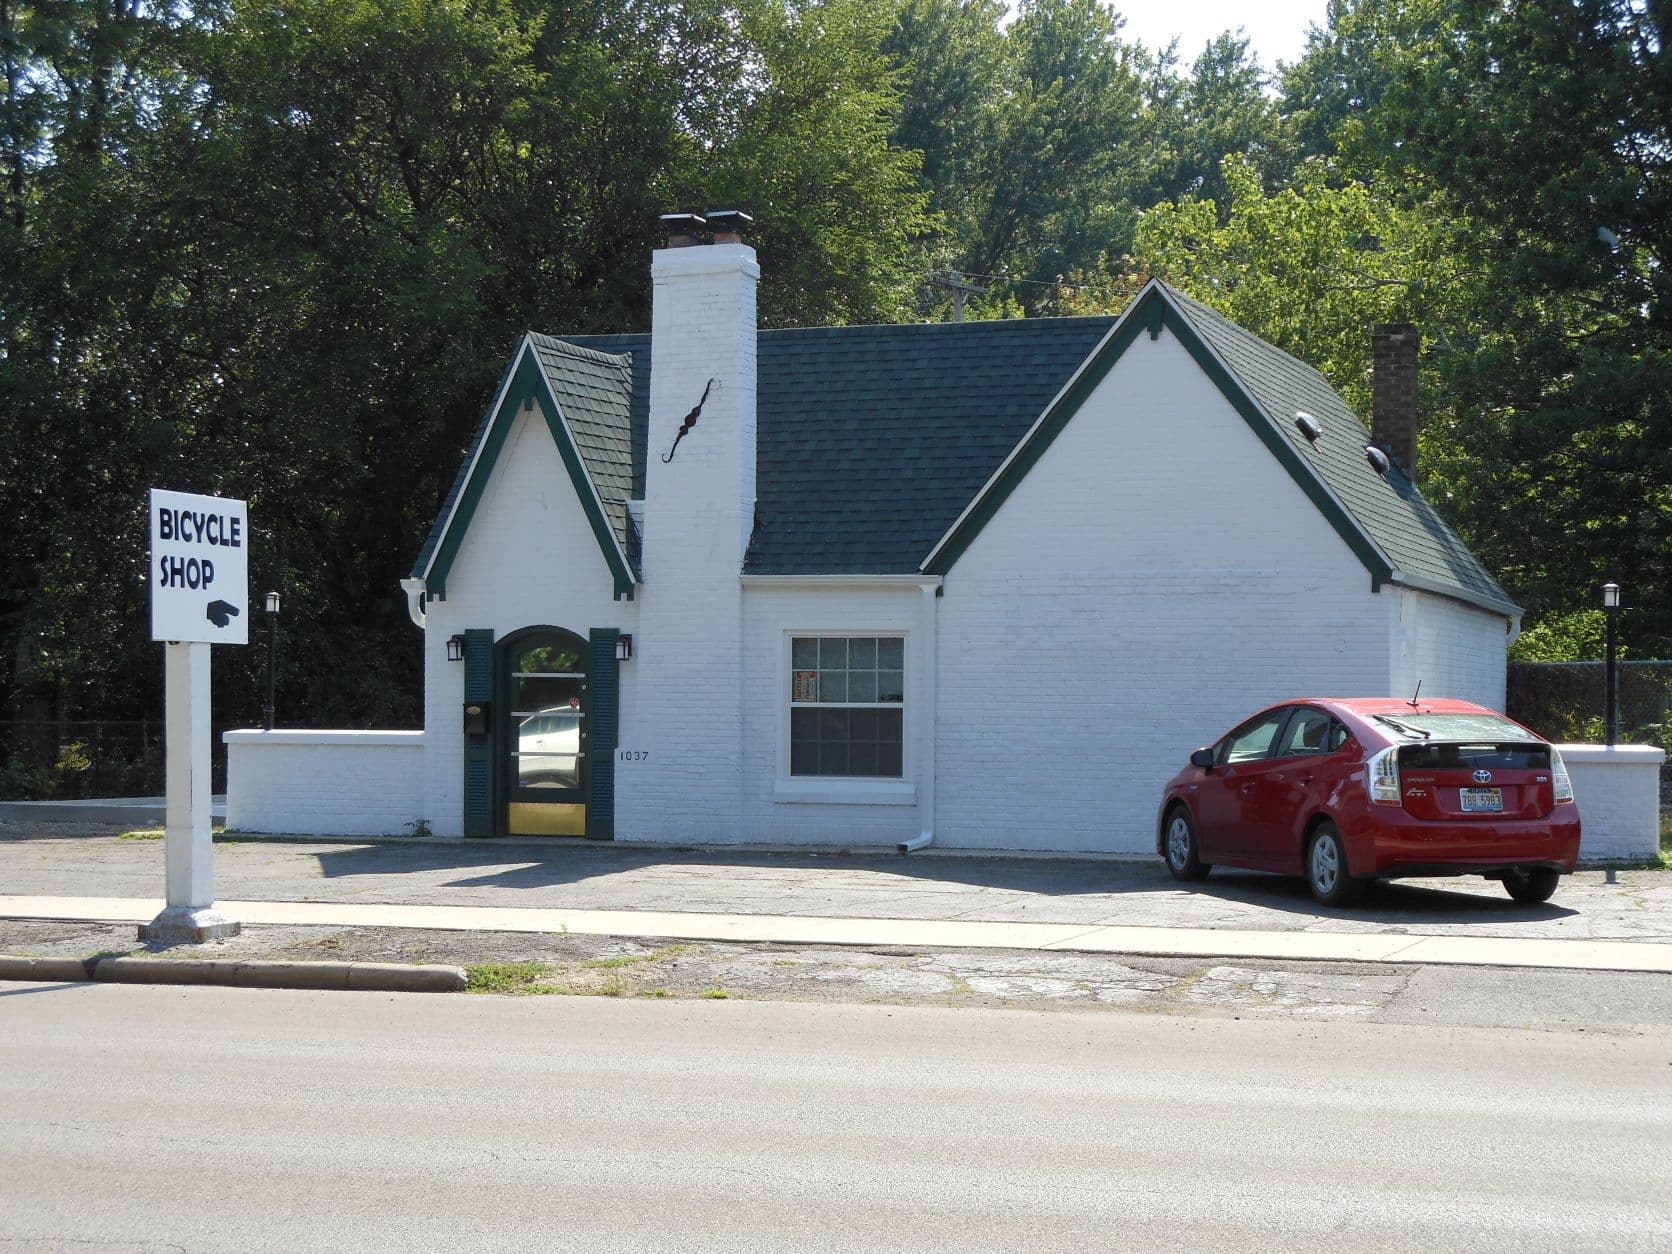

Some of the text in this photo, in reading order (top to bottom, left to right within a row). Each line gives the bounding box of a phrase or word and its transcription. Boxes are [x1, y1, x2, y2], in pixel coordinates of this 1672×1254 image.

[159, 508, 241, 547] BICYCLE
[160, 555, 215, 590] SHOP
[620, 751, 649, 761] 1037
